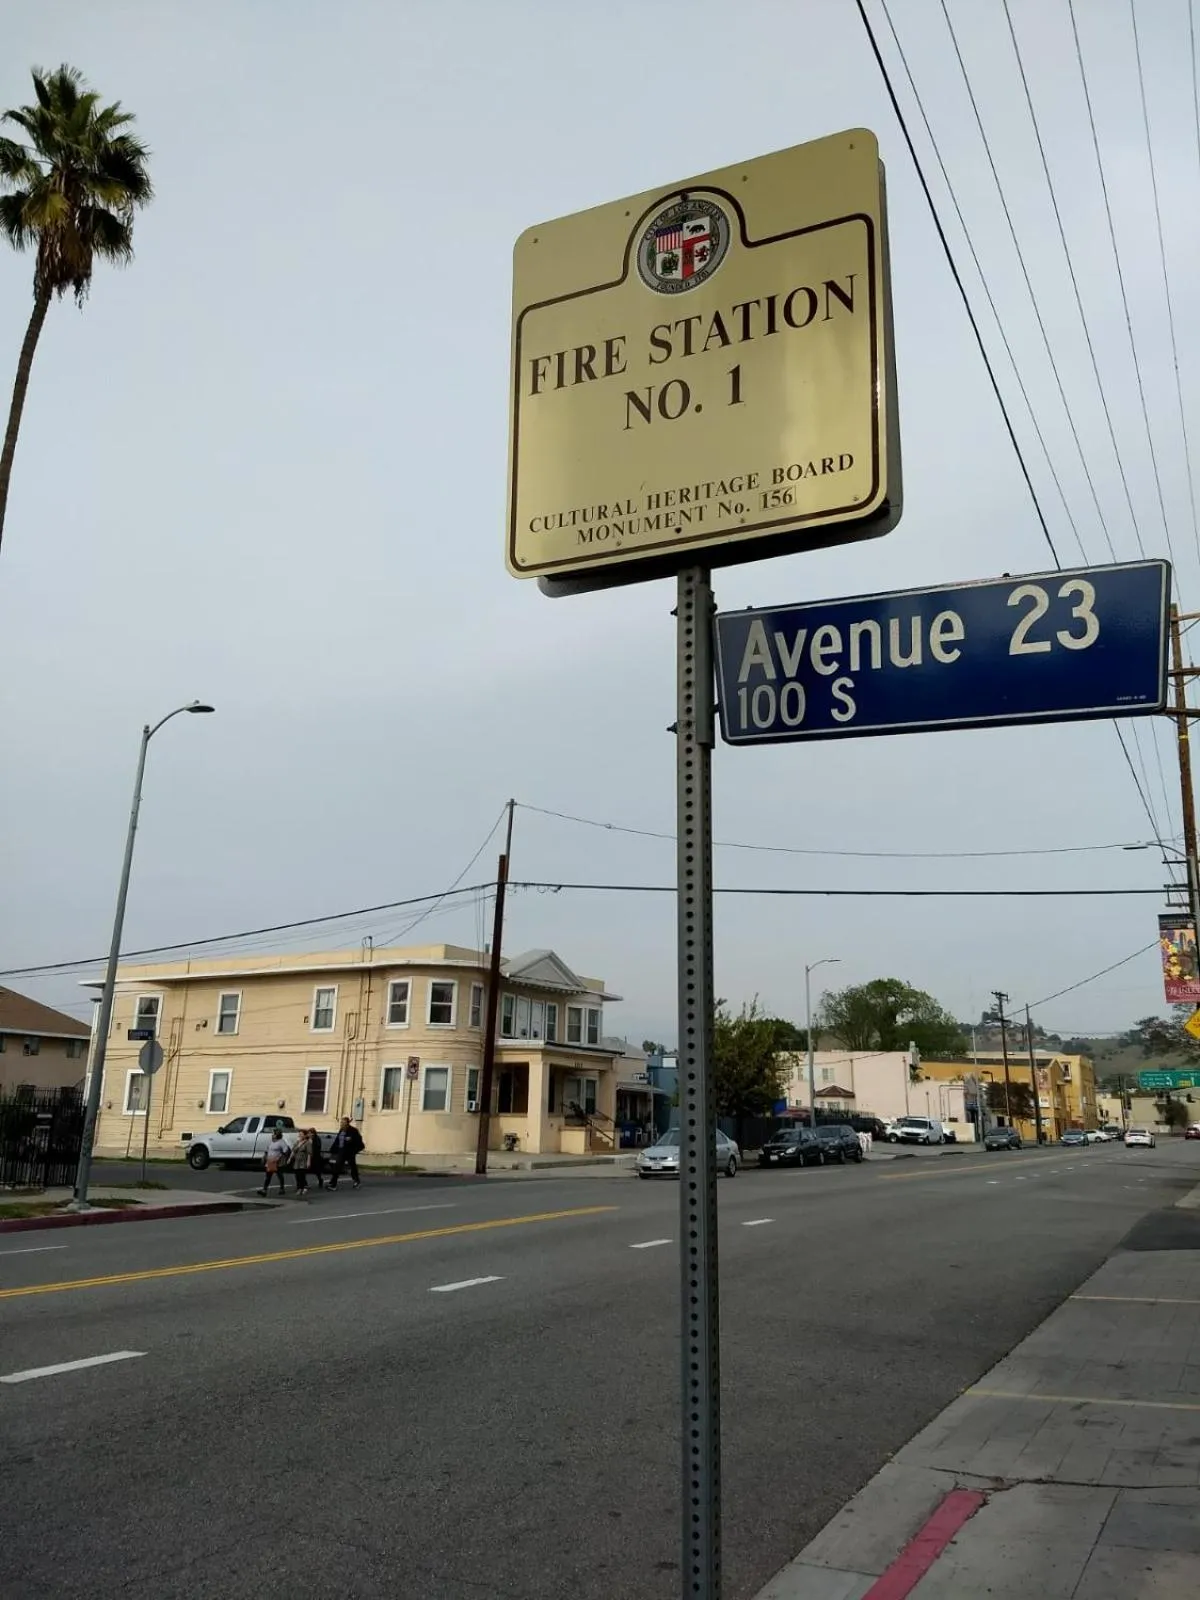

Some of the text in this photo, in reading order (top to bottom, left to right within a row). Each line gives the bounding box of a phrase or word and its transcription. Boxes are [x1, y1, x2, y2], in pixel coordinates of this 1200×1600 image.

[528, 274, 857, 396] FIRE STATION
[622, 364, 745, 431] NO. 1
[529, 453, 854, 533] CULTURAL HERITAGE BOARD
[576, 488, 793, 545] MONUMENT No. 156
[737, 579, 1100, 682] Avenue 23
[737, 676, 856, 730] 100 S
